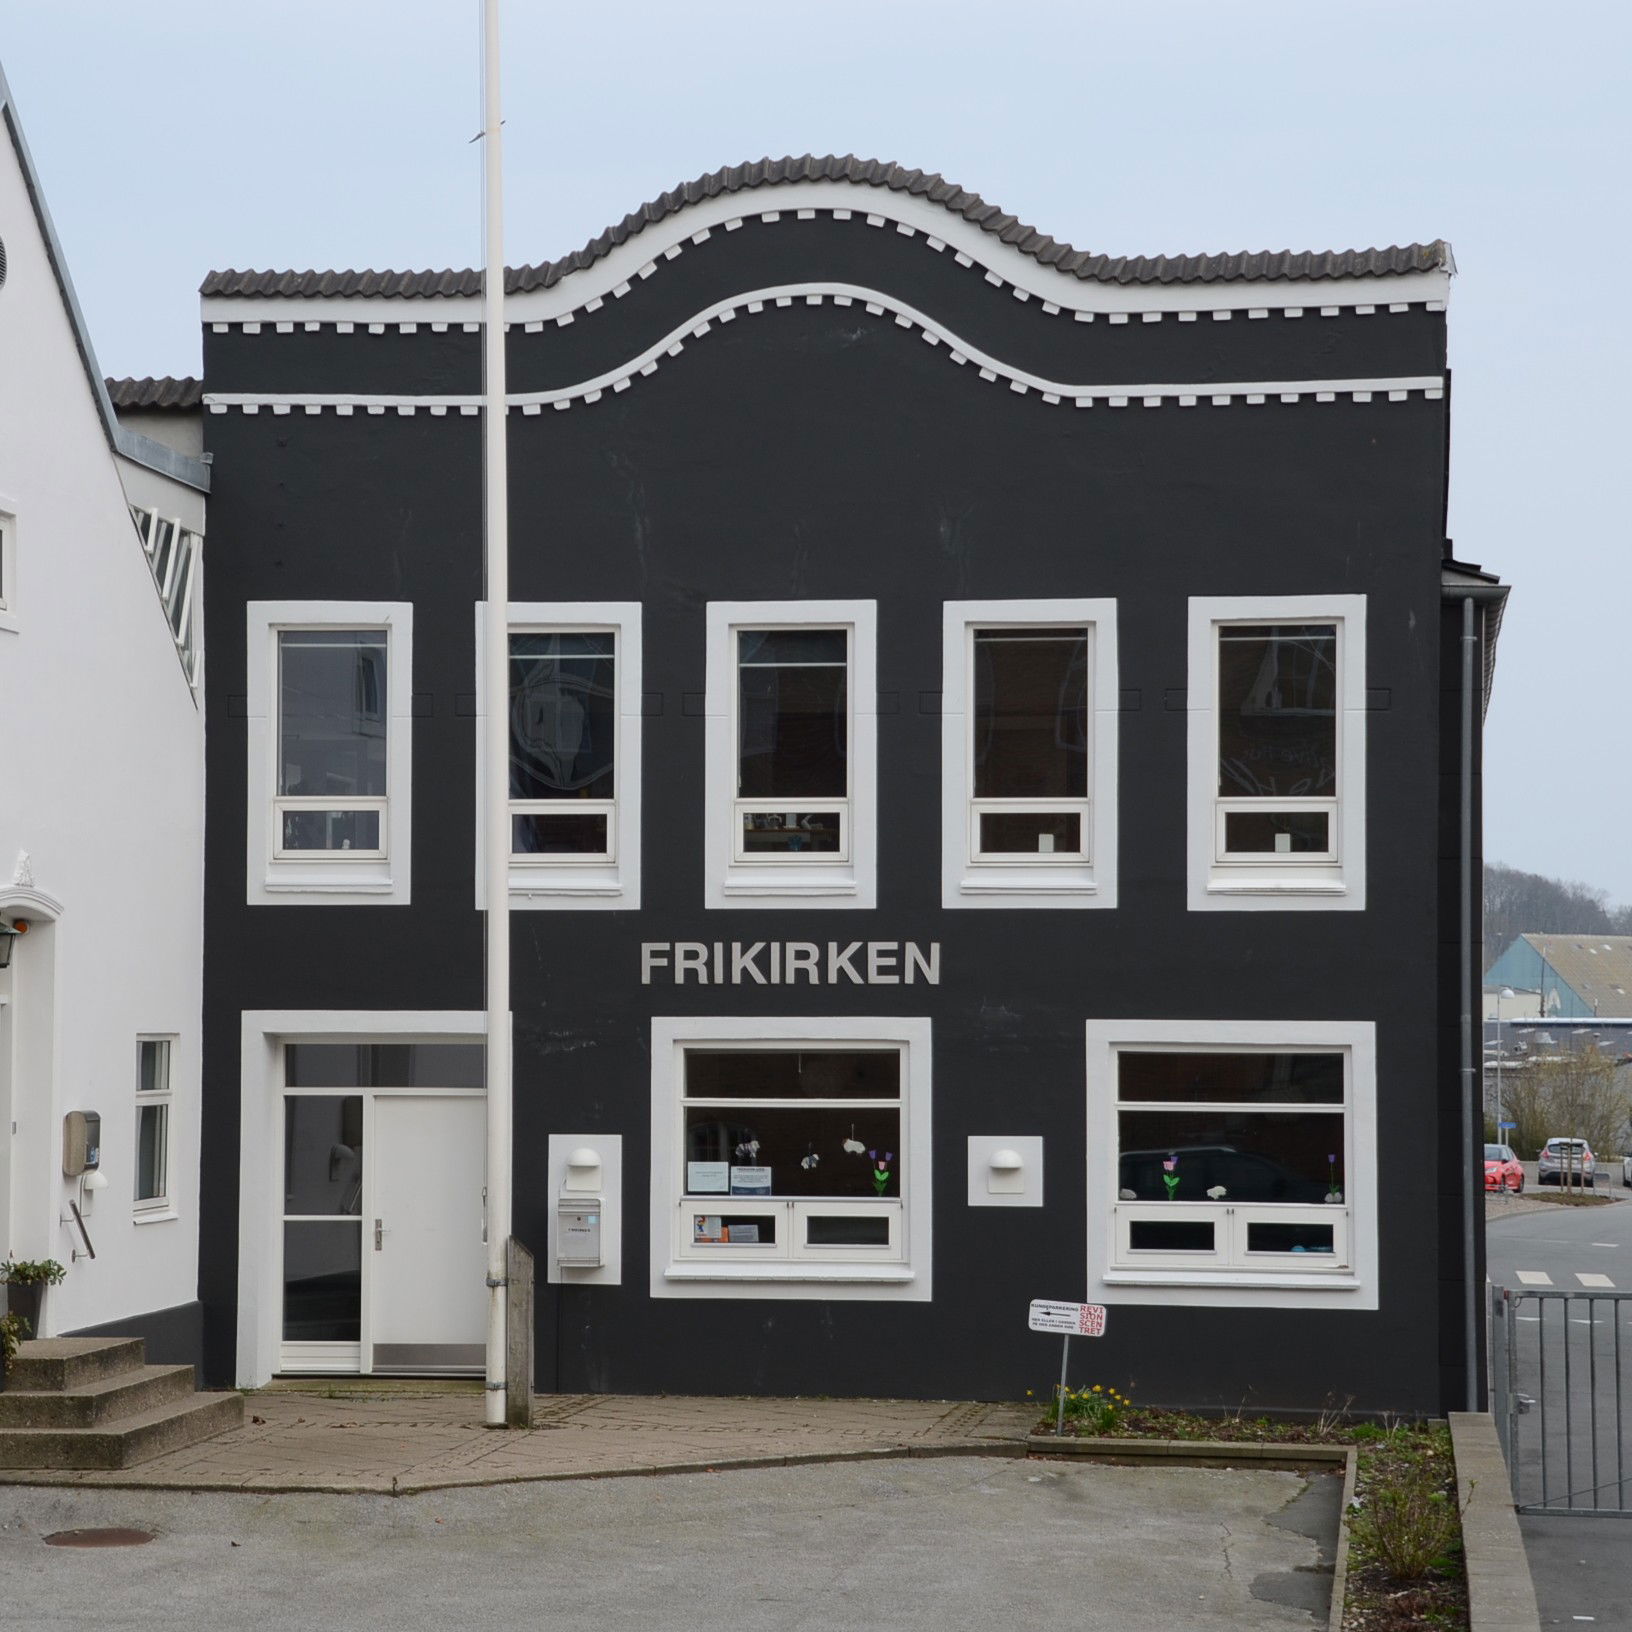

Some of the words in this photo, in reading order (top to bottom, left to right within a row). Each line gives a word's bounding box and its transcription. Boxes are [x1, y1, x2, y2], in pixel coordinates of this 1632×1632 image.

[641, 942, 940, 985] FRIKIRKEN
[1080, 1305, 1103, 1314] REVI
[1080, 1312, 1103, 1321] SION
[1079, 1319, 1102, 1328] SCEN
[1079, 1327, 1101, 1335] TRET
